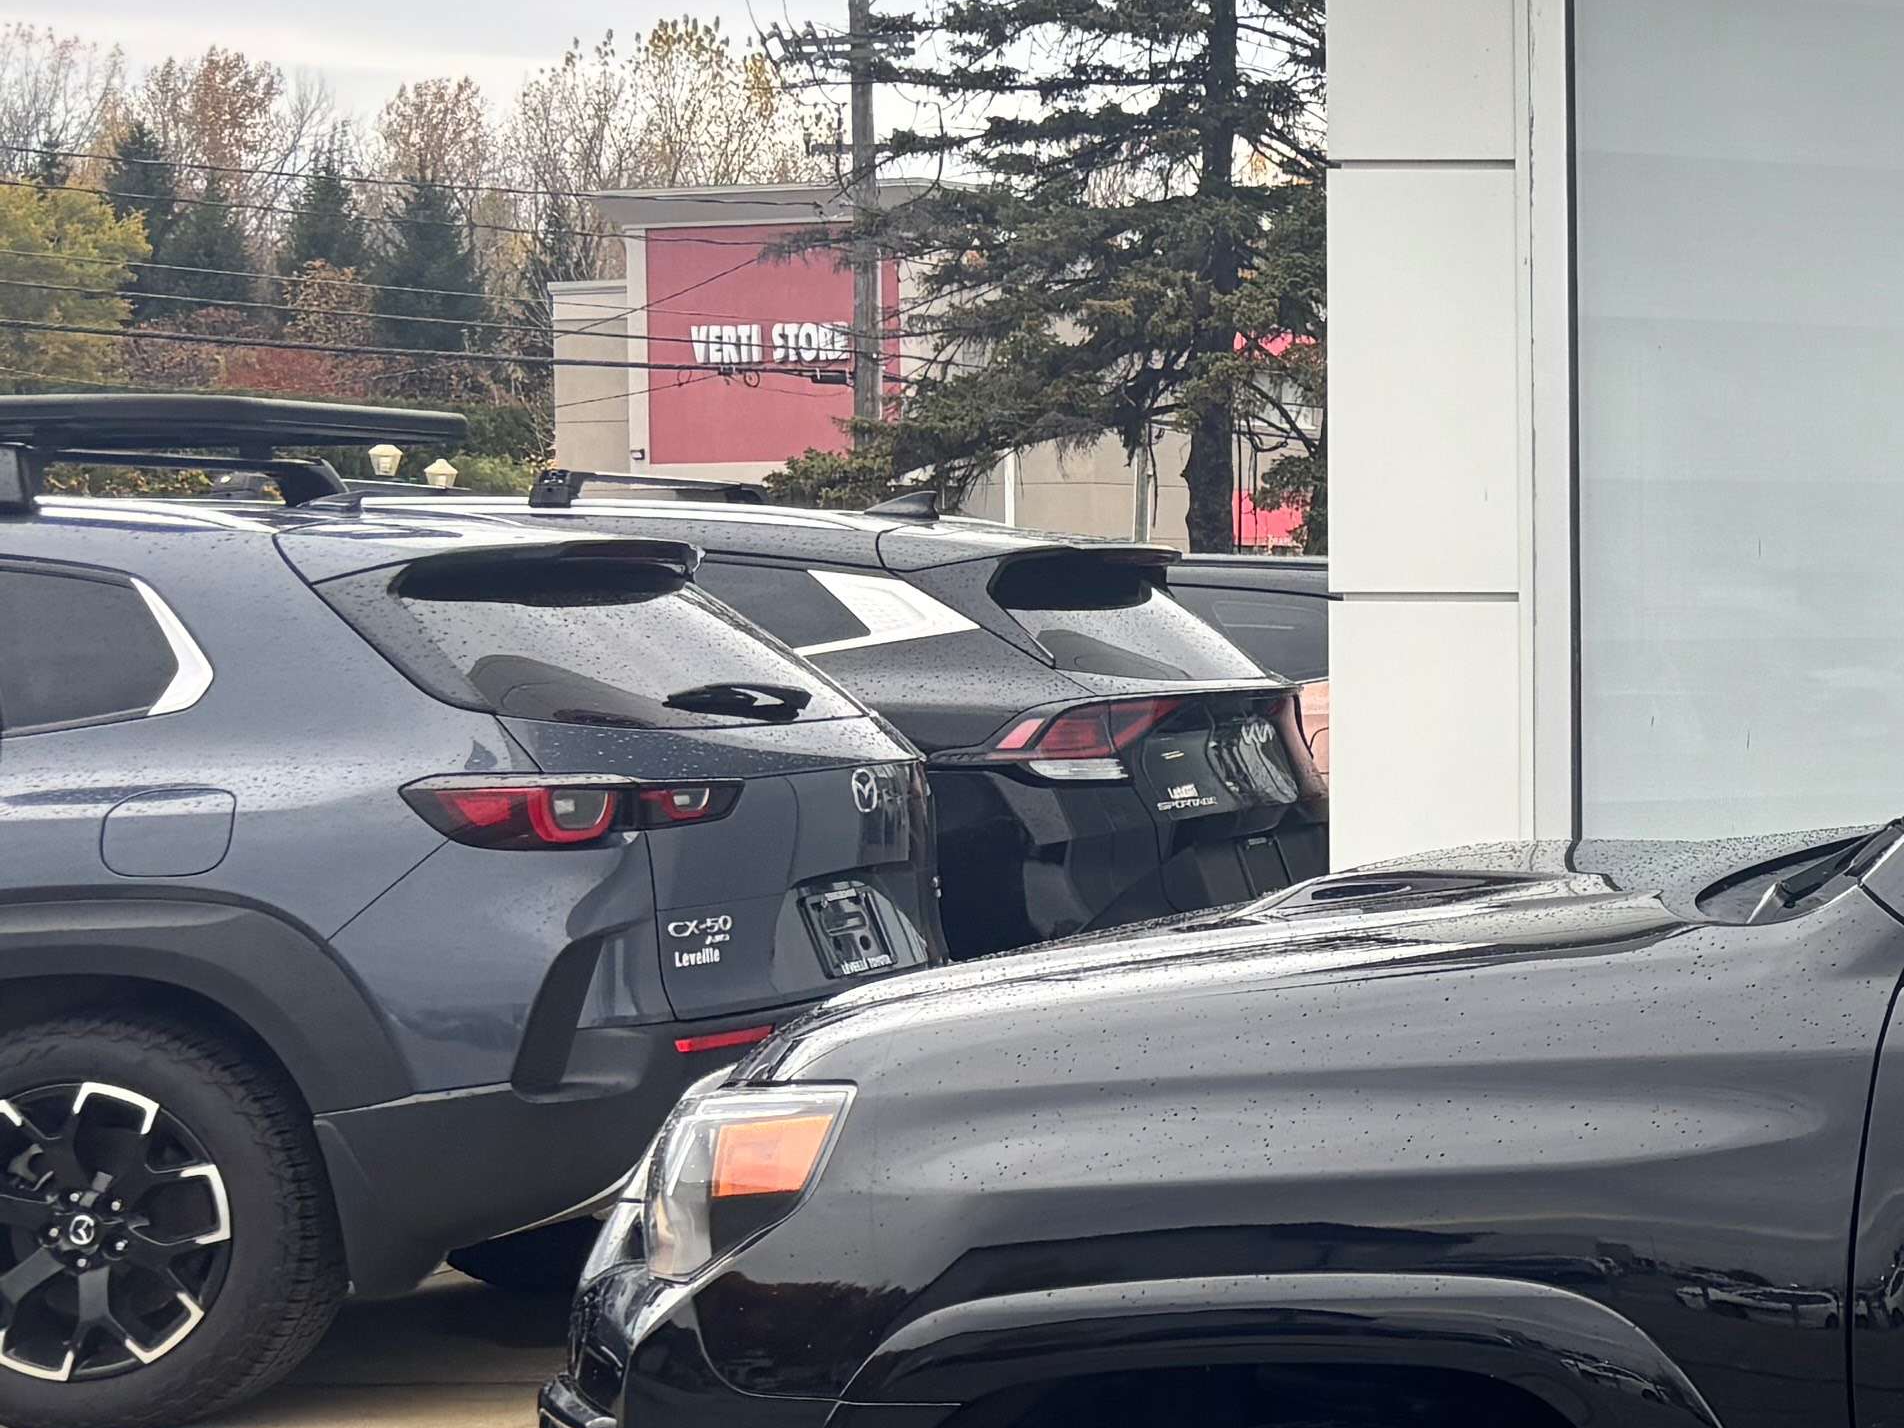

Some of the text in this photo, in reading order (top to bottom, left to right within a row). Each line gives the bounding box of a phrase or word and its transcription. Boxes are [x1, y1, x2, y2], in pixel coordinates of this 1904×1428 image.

[690, 321, 850, 364] VERTI STORE
[668, 915, 732, 937] CX-50
